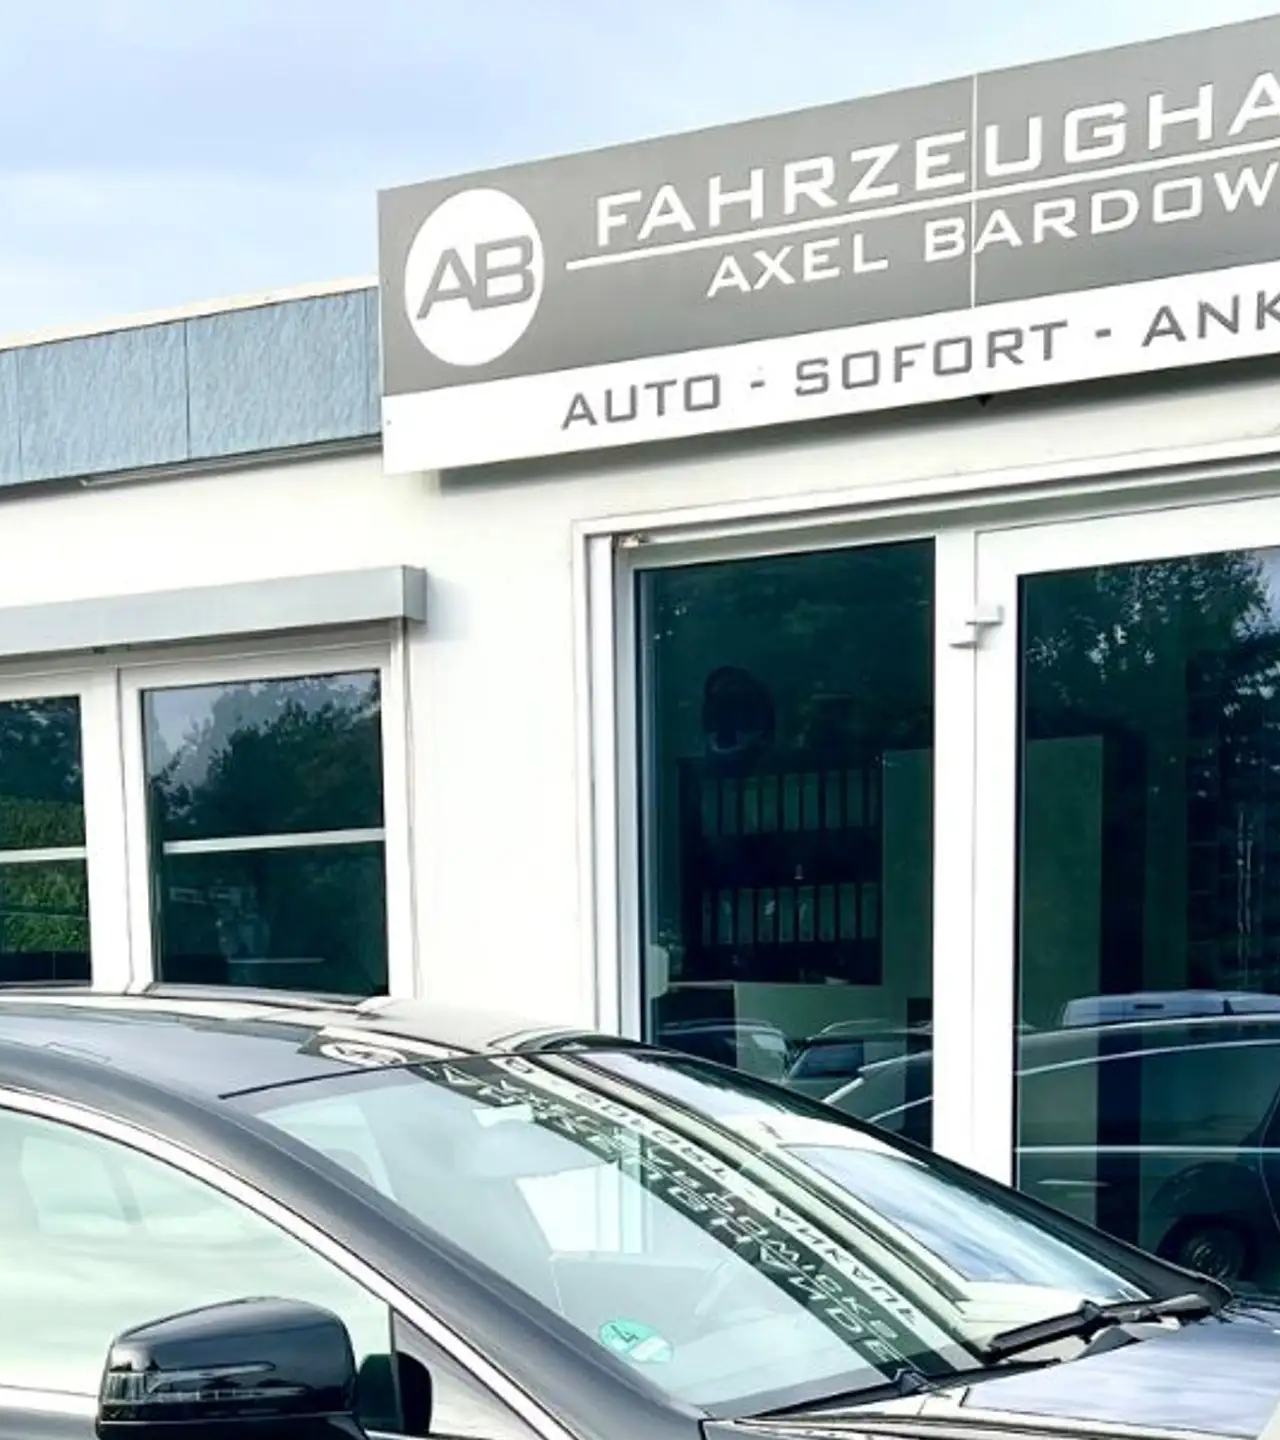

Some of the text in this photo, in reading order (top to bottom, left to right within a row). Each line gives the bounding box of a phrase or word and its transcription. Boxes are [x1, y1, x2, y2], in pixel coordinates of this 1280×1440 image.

[416, 233, 536, 320] AB
[706, 232, 889, 298] AXEL
[561, 372, 721, 431] AUTO
[794, 319, 1068, 397] SOFORT
